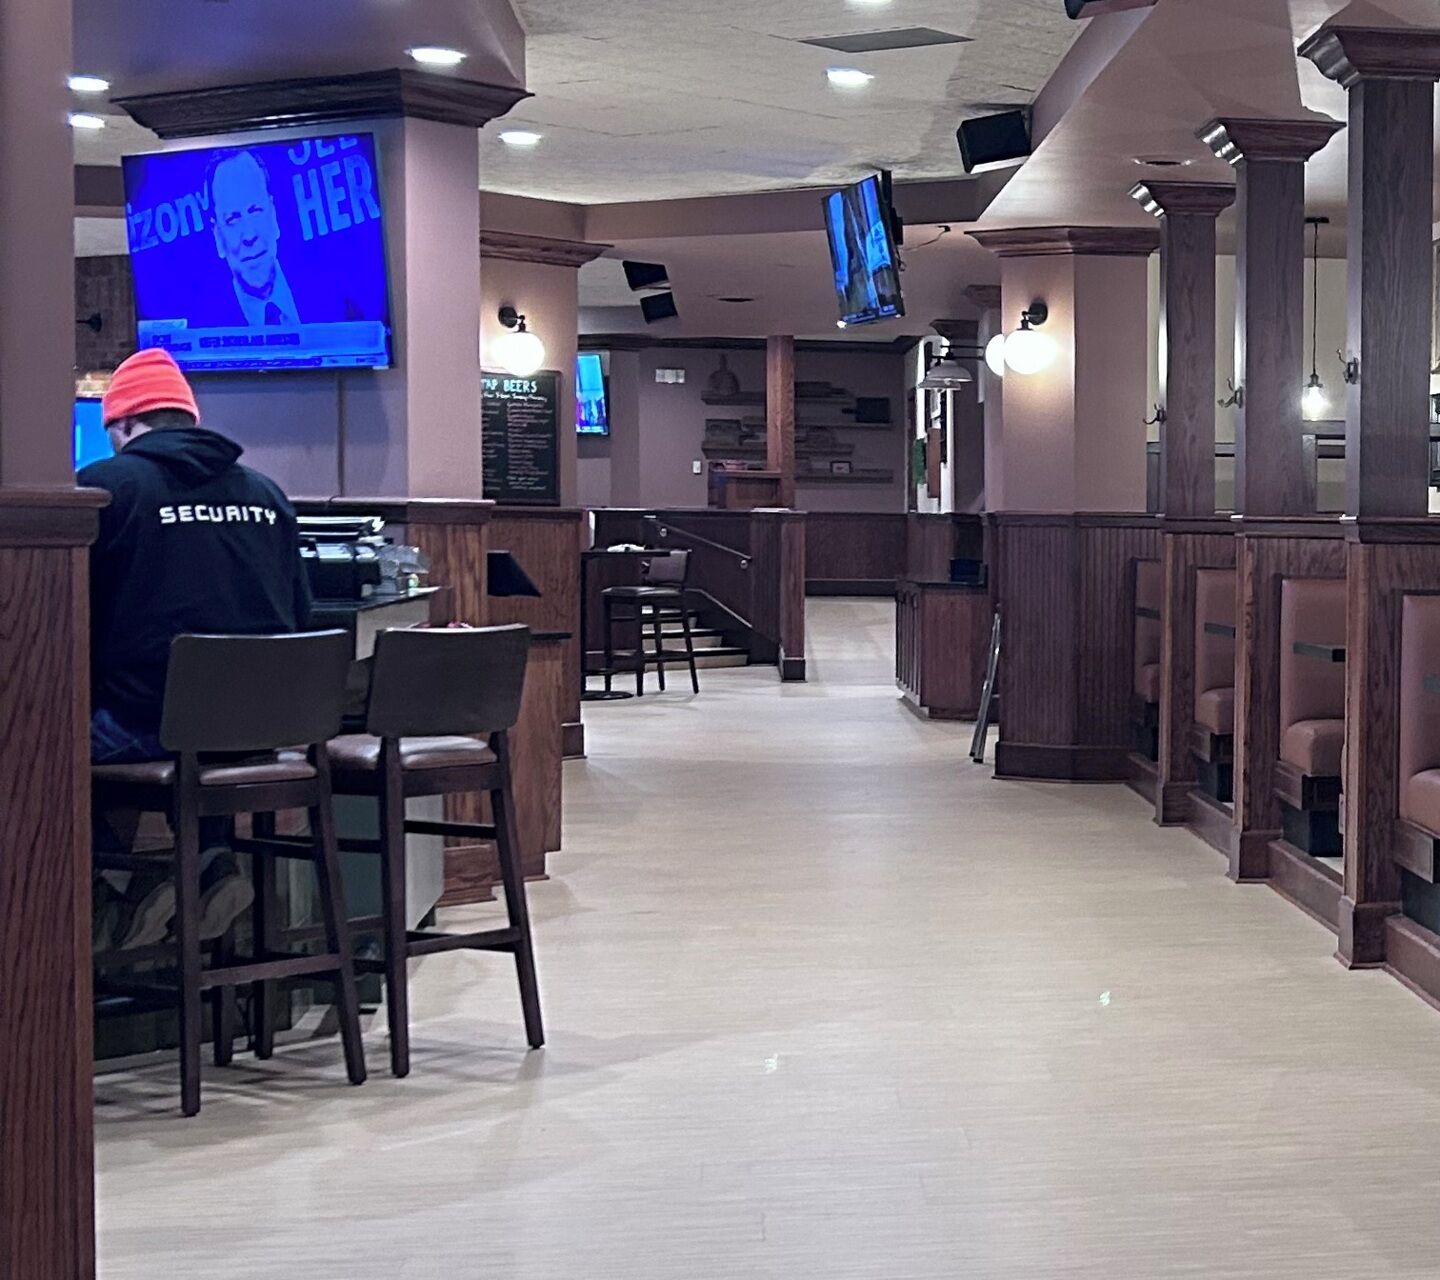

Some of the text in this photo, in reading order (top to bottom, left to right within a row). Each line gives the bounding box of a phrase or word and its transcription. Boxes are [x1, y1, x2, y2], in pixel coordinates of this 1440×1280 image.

[293, 154, 381, 241] HER
[503, 379, 537, 393] BEERS
[159, 504, 276, 525] SECURITY
